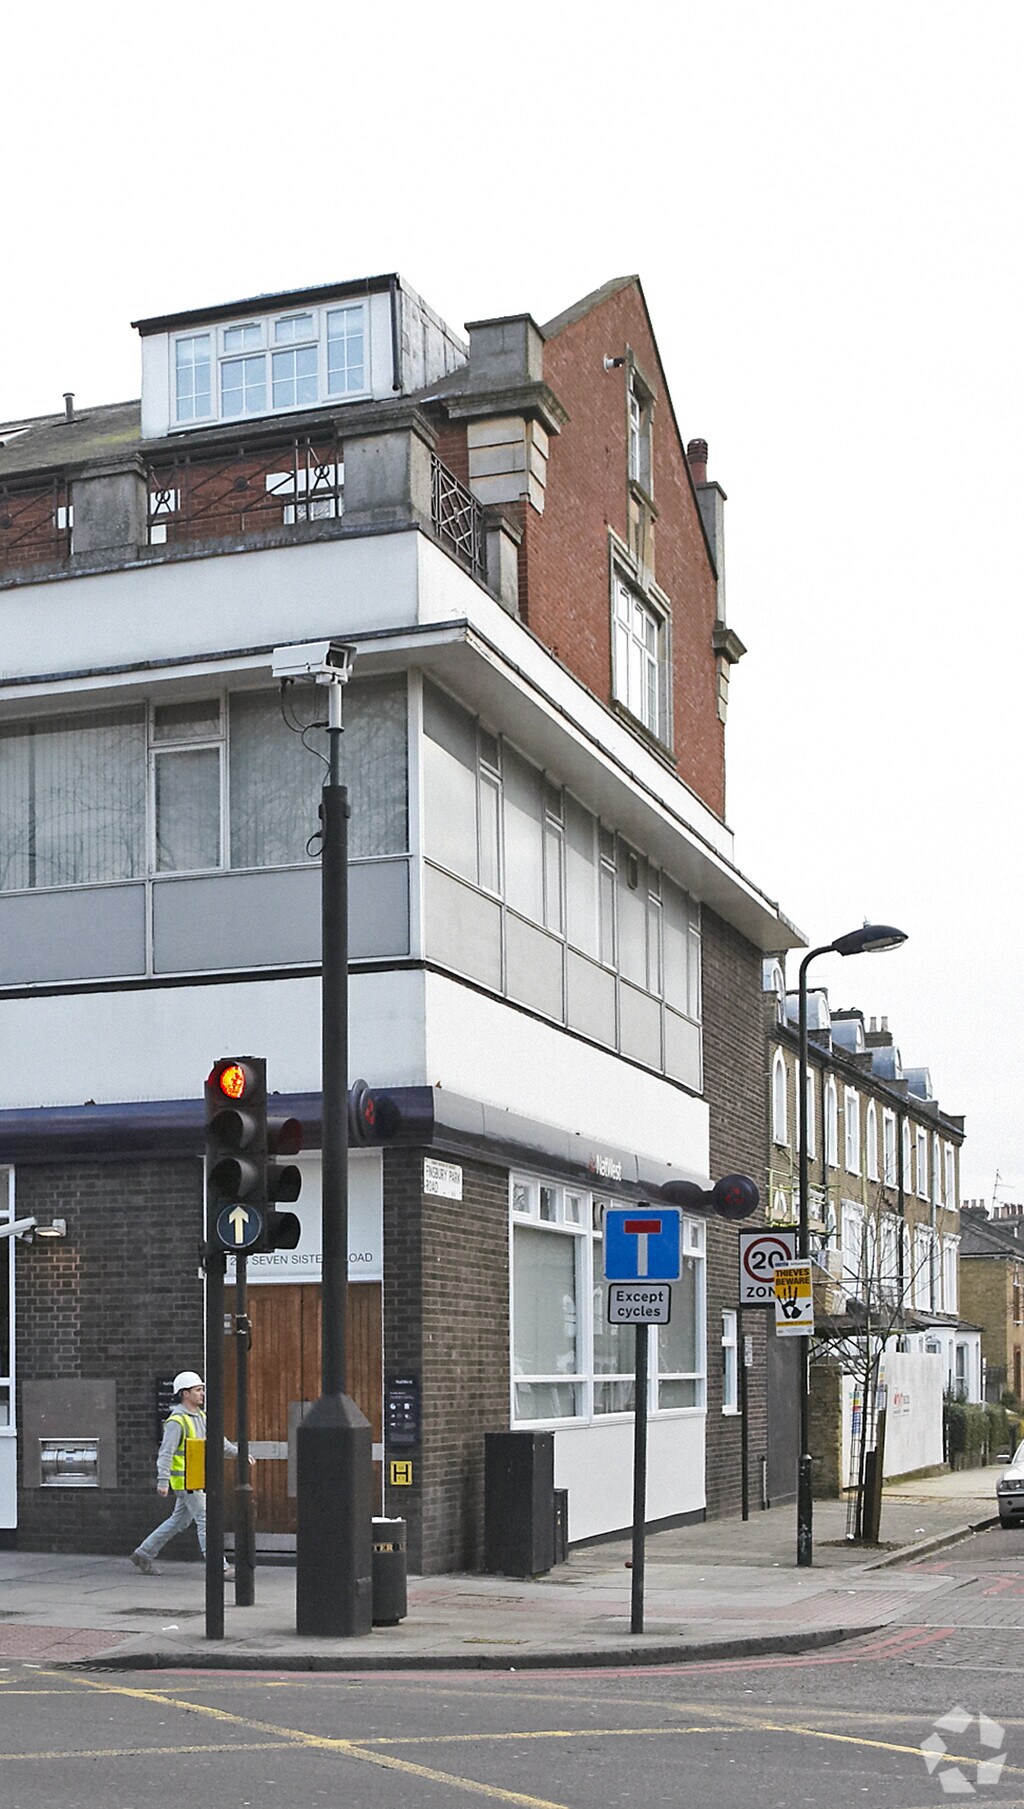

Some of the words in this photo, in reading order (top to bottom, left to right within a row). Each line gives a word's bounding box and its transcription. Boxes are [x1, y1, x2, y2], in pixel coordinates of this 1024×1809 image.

[252, 1256, 288, 1265] SEVEN
[291, 1254, 323, 1264] SISTE
[348, 1253, 373, 1263] OAD
[751, 1251, 784, 1269] 20
[775, 1268, 810, 1277] THIEVES
[775, 1278, 810, 1286] BEWARE
[616, 1291, 664, 1304] Except
[746, 1286, 776, 1298] ZON
[617, 1305, 661, 1318] cycles
[393, 1464, 409, 1482] H
